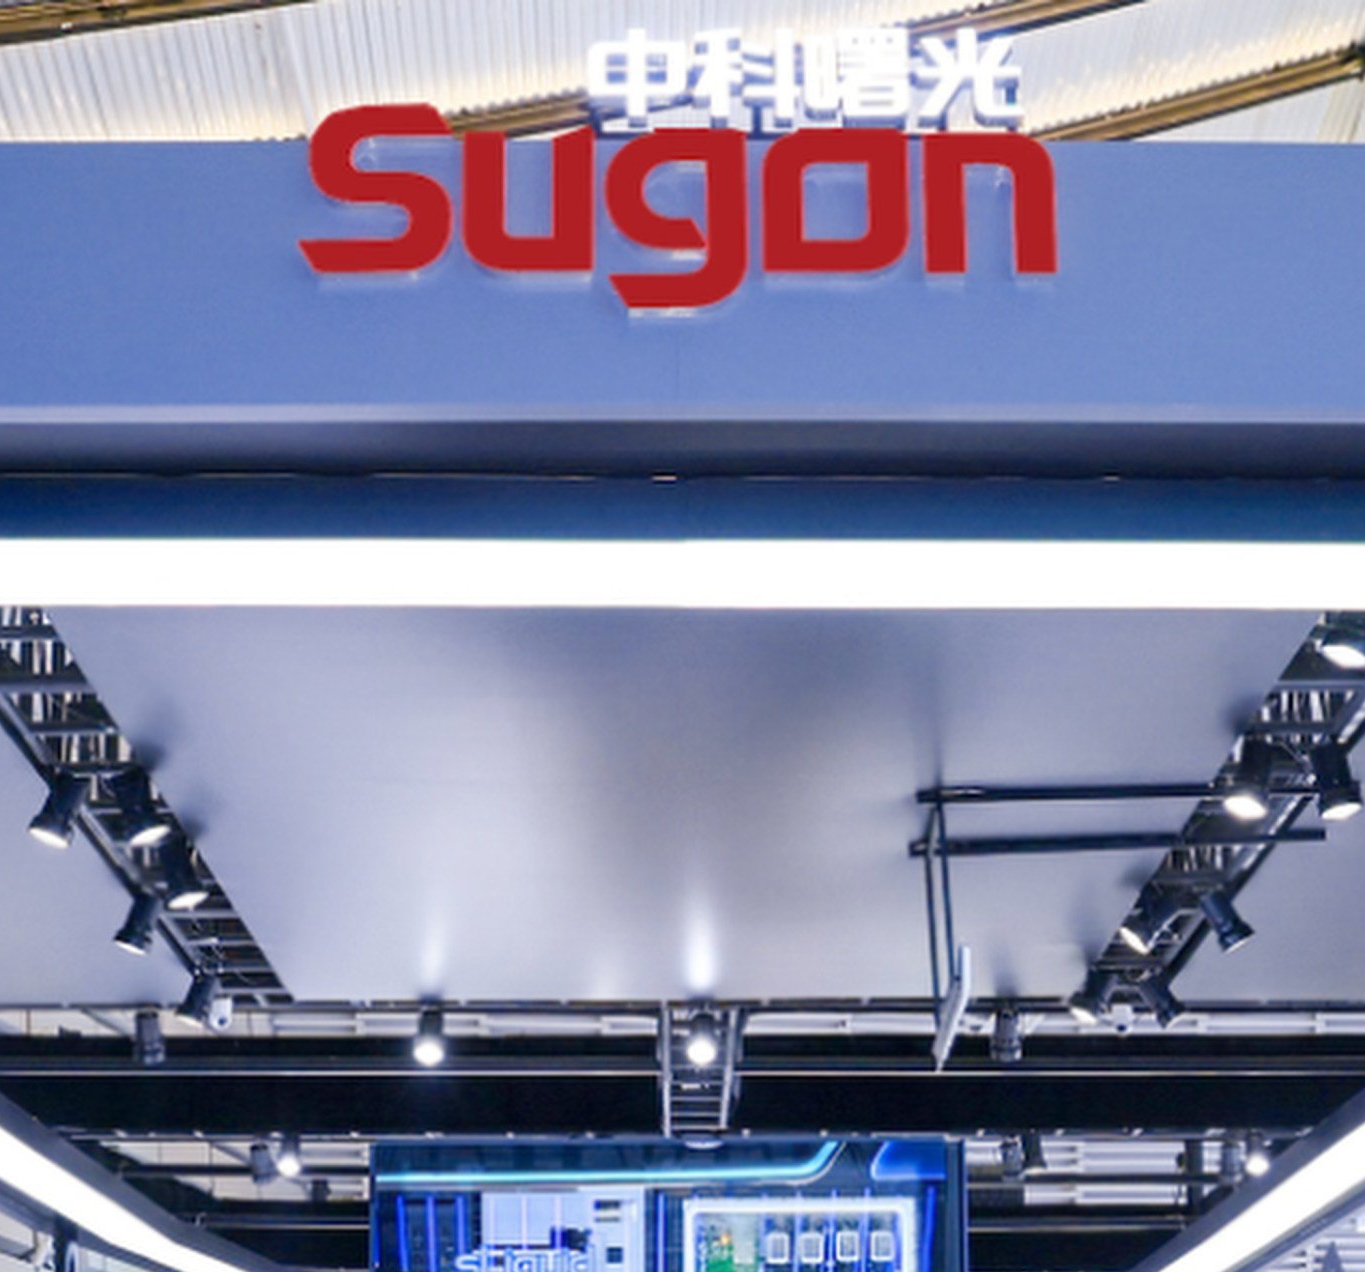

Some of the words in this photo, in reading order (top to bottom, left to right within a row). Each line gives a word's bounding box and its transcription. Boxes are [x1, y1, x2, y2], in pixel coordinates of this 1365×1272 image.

[586, 27, 1023, 133] 中科曙光
[297, 103, 1058, 309] Sugon
